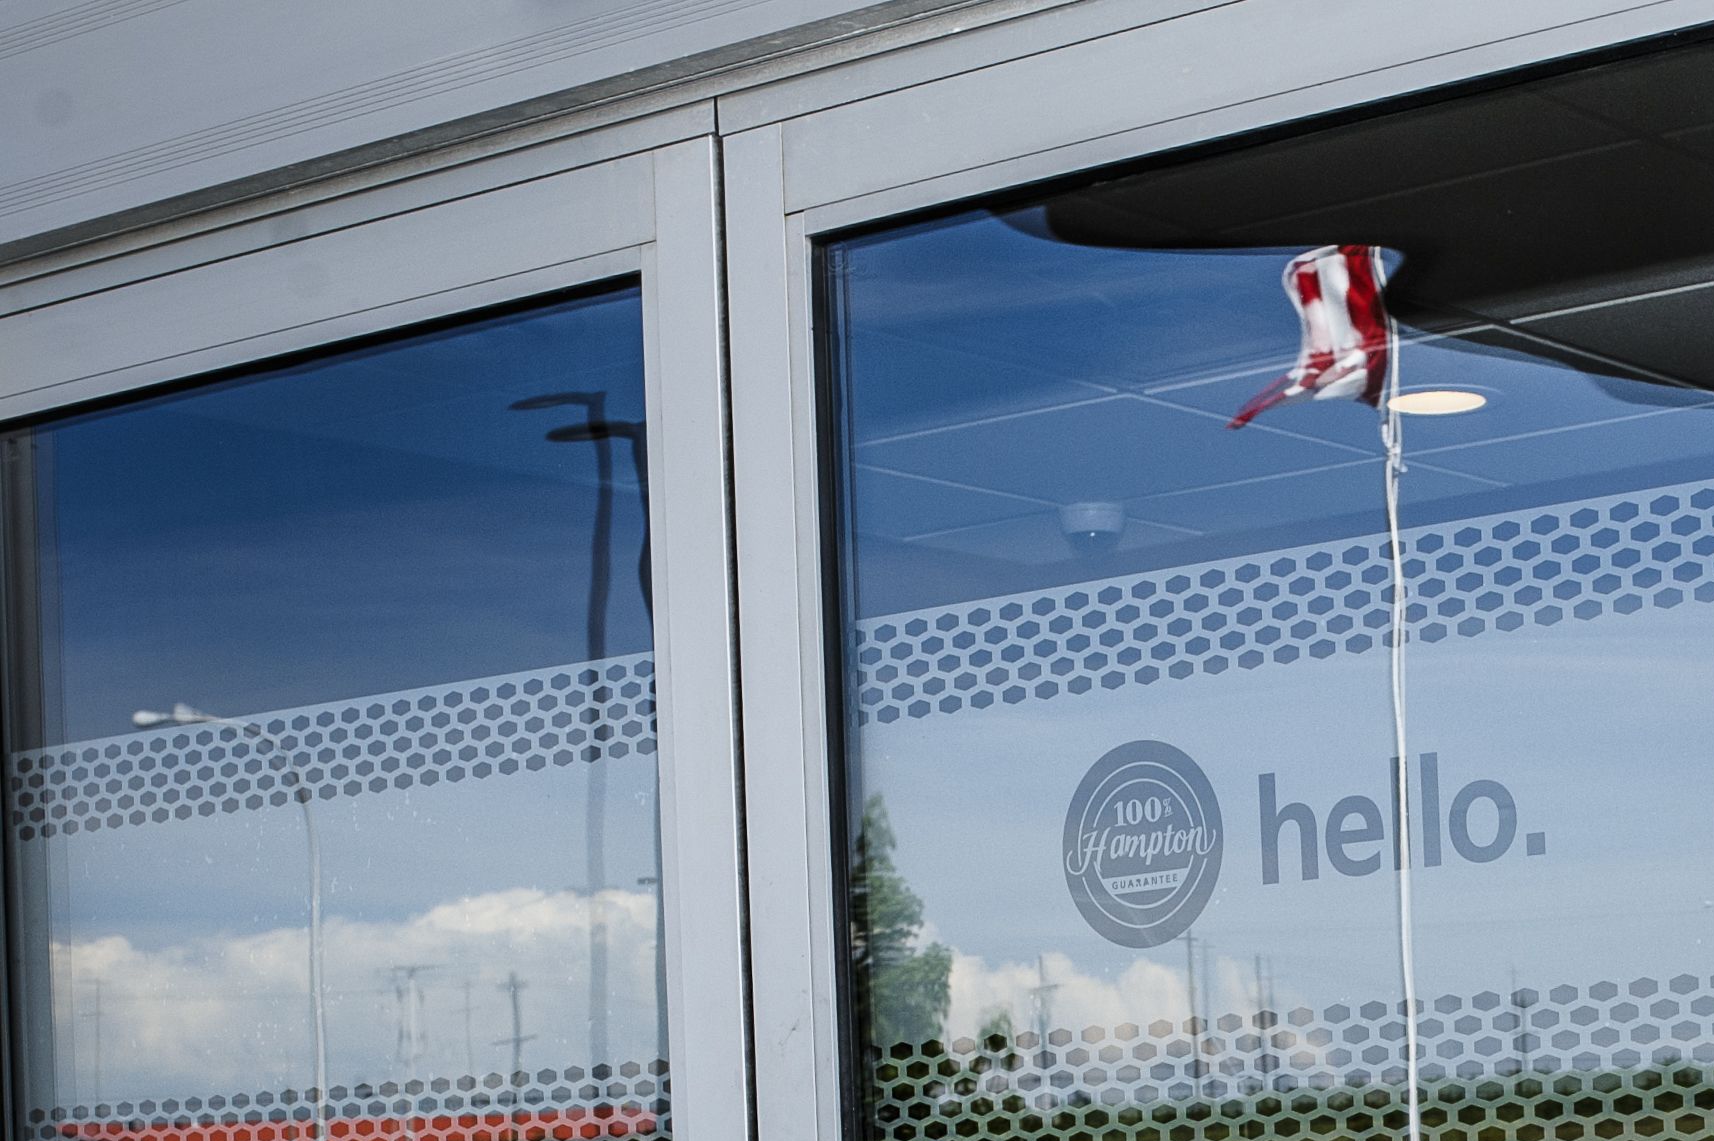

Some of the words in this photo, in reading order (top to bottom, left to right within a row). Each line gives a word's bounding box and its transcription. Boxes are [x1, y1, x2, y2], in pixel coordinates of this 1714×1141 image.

[1258, 752, 1546, 885] hello.
[1066, 824, 1216, 876] Hampton
[1111, 873, 1178, 890] GUARANTEE
